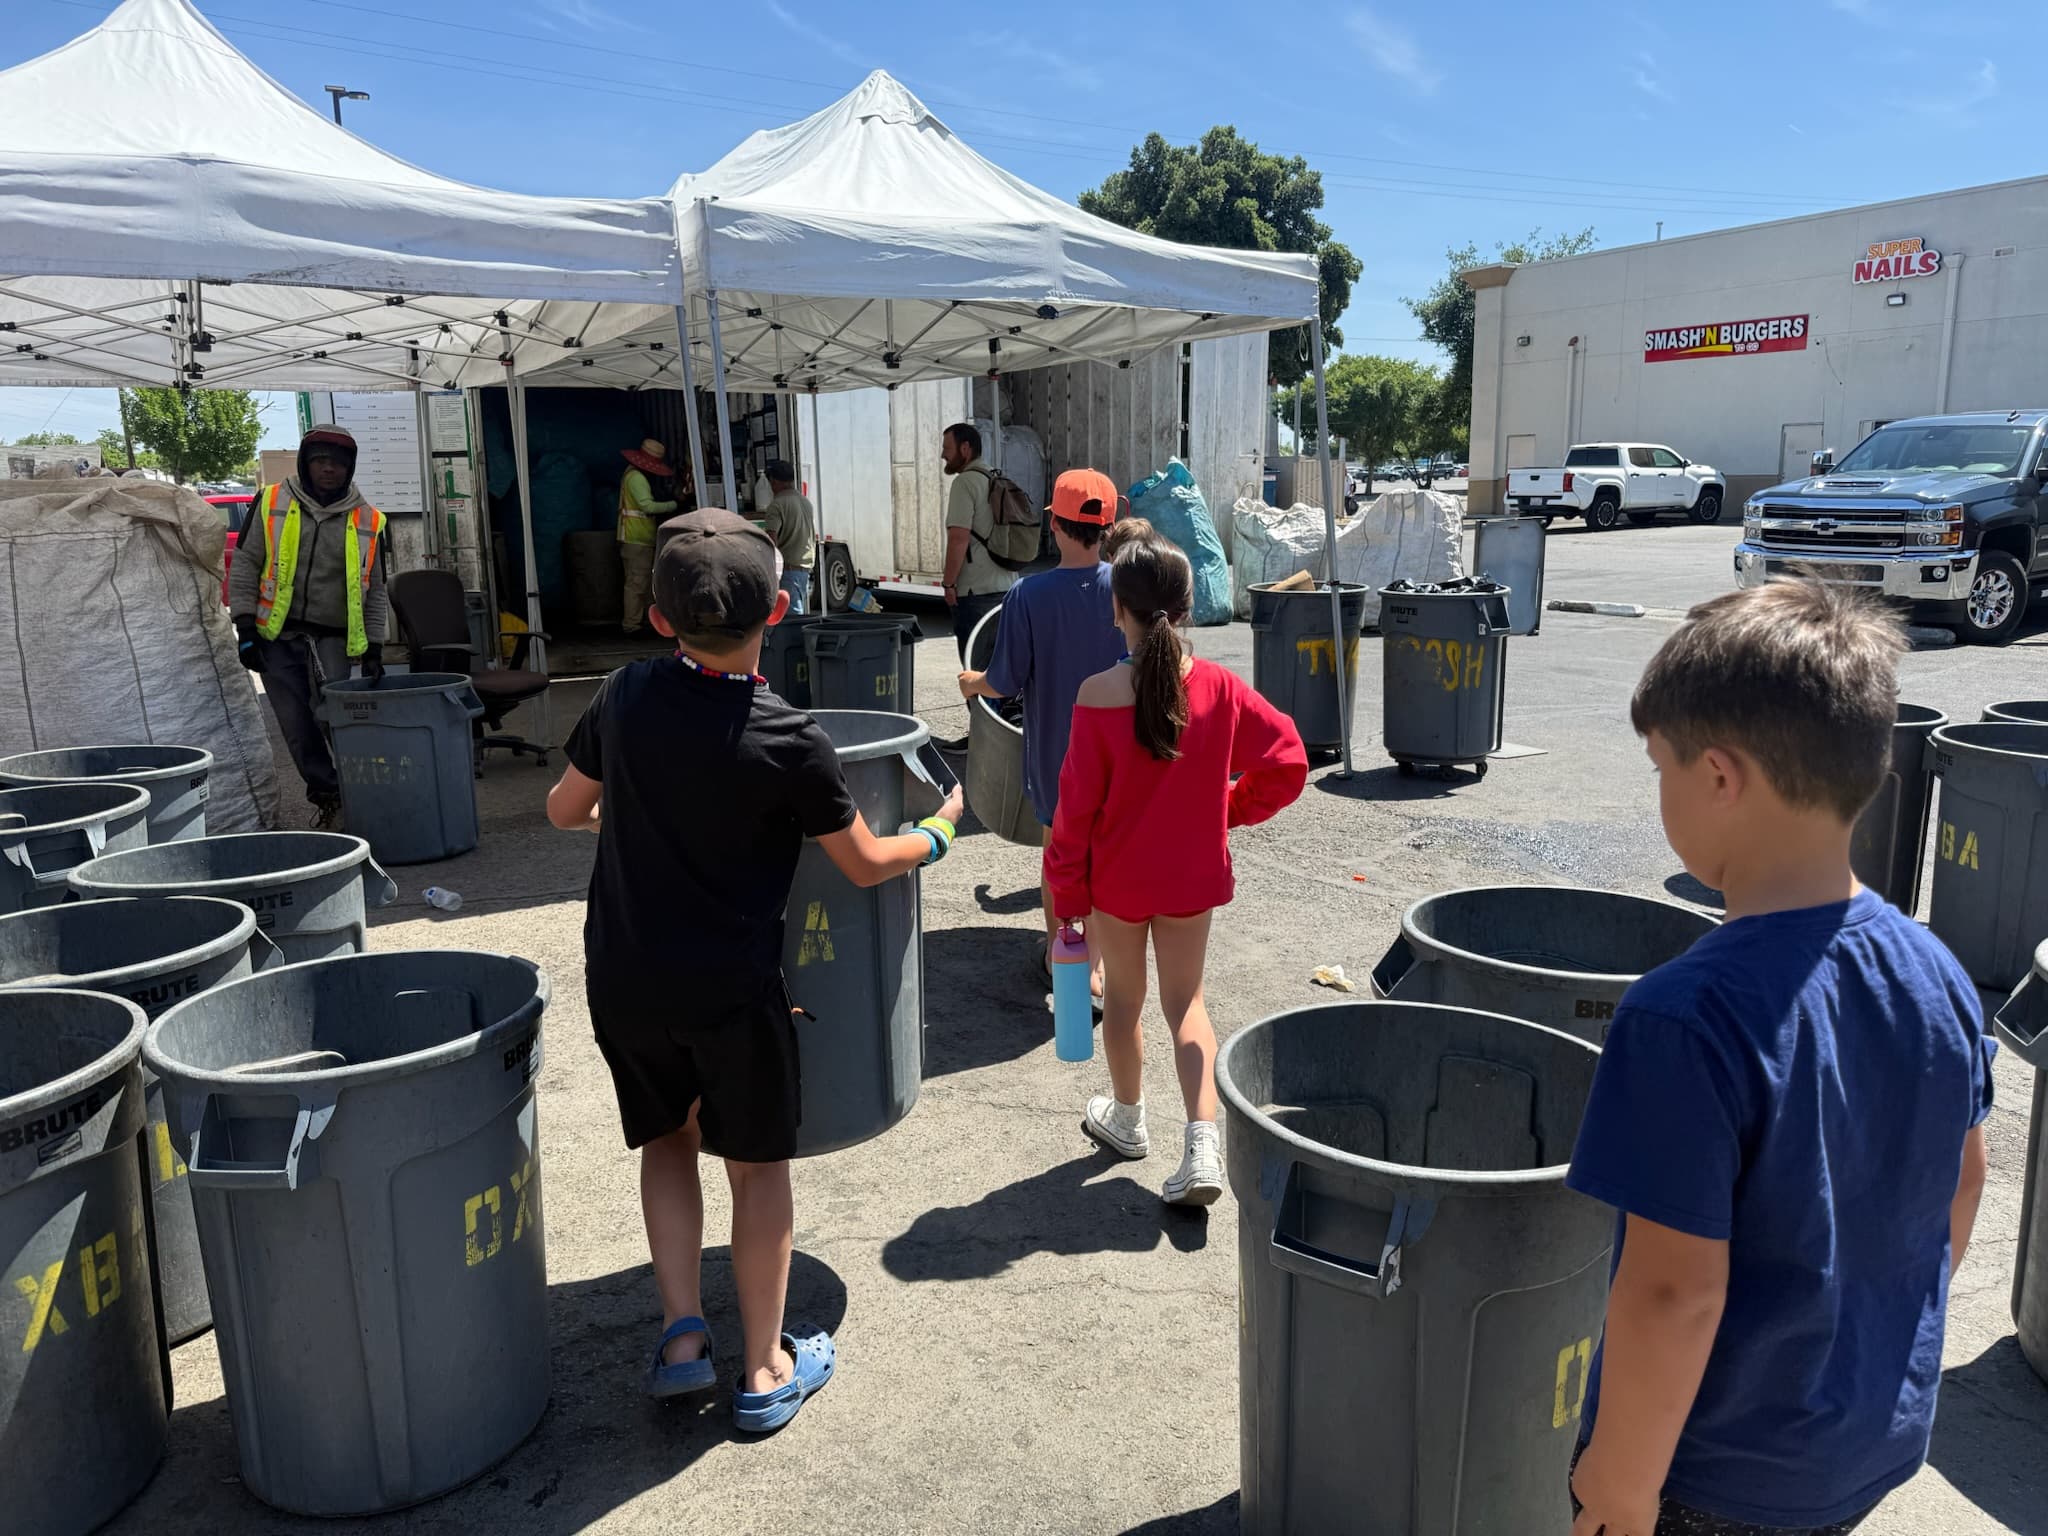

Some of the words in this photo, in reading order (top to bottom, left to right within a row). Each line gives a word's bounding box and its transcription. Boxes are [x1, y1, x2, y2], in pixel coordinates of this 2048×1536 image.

[1868, 239, 1921, 259] SUPER
[1854, 252, 1938, 282] NAILS
[1720, 317, 1804, 344] BURGERS
[1734, 343, 1746, 353] TO
[1746, 342, 1760, 352] GO
[0, 1092, 101, 1153] BRUTE
